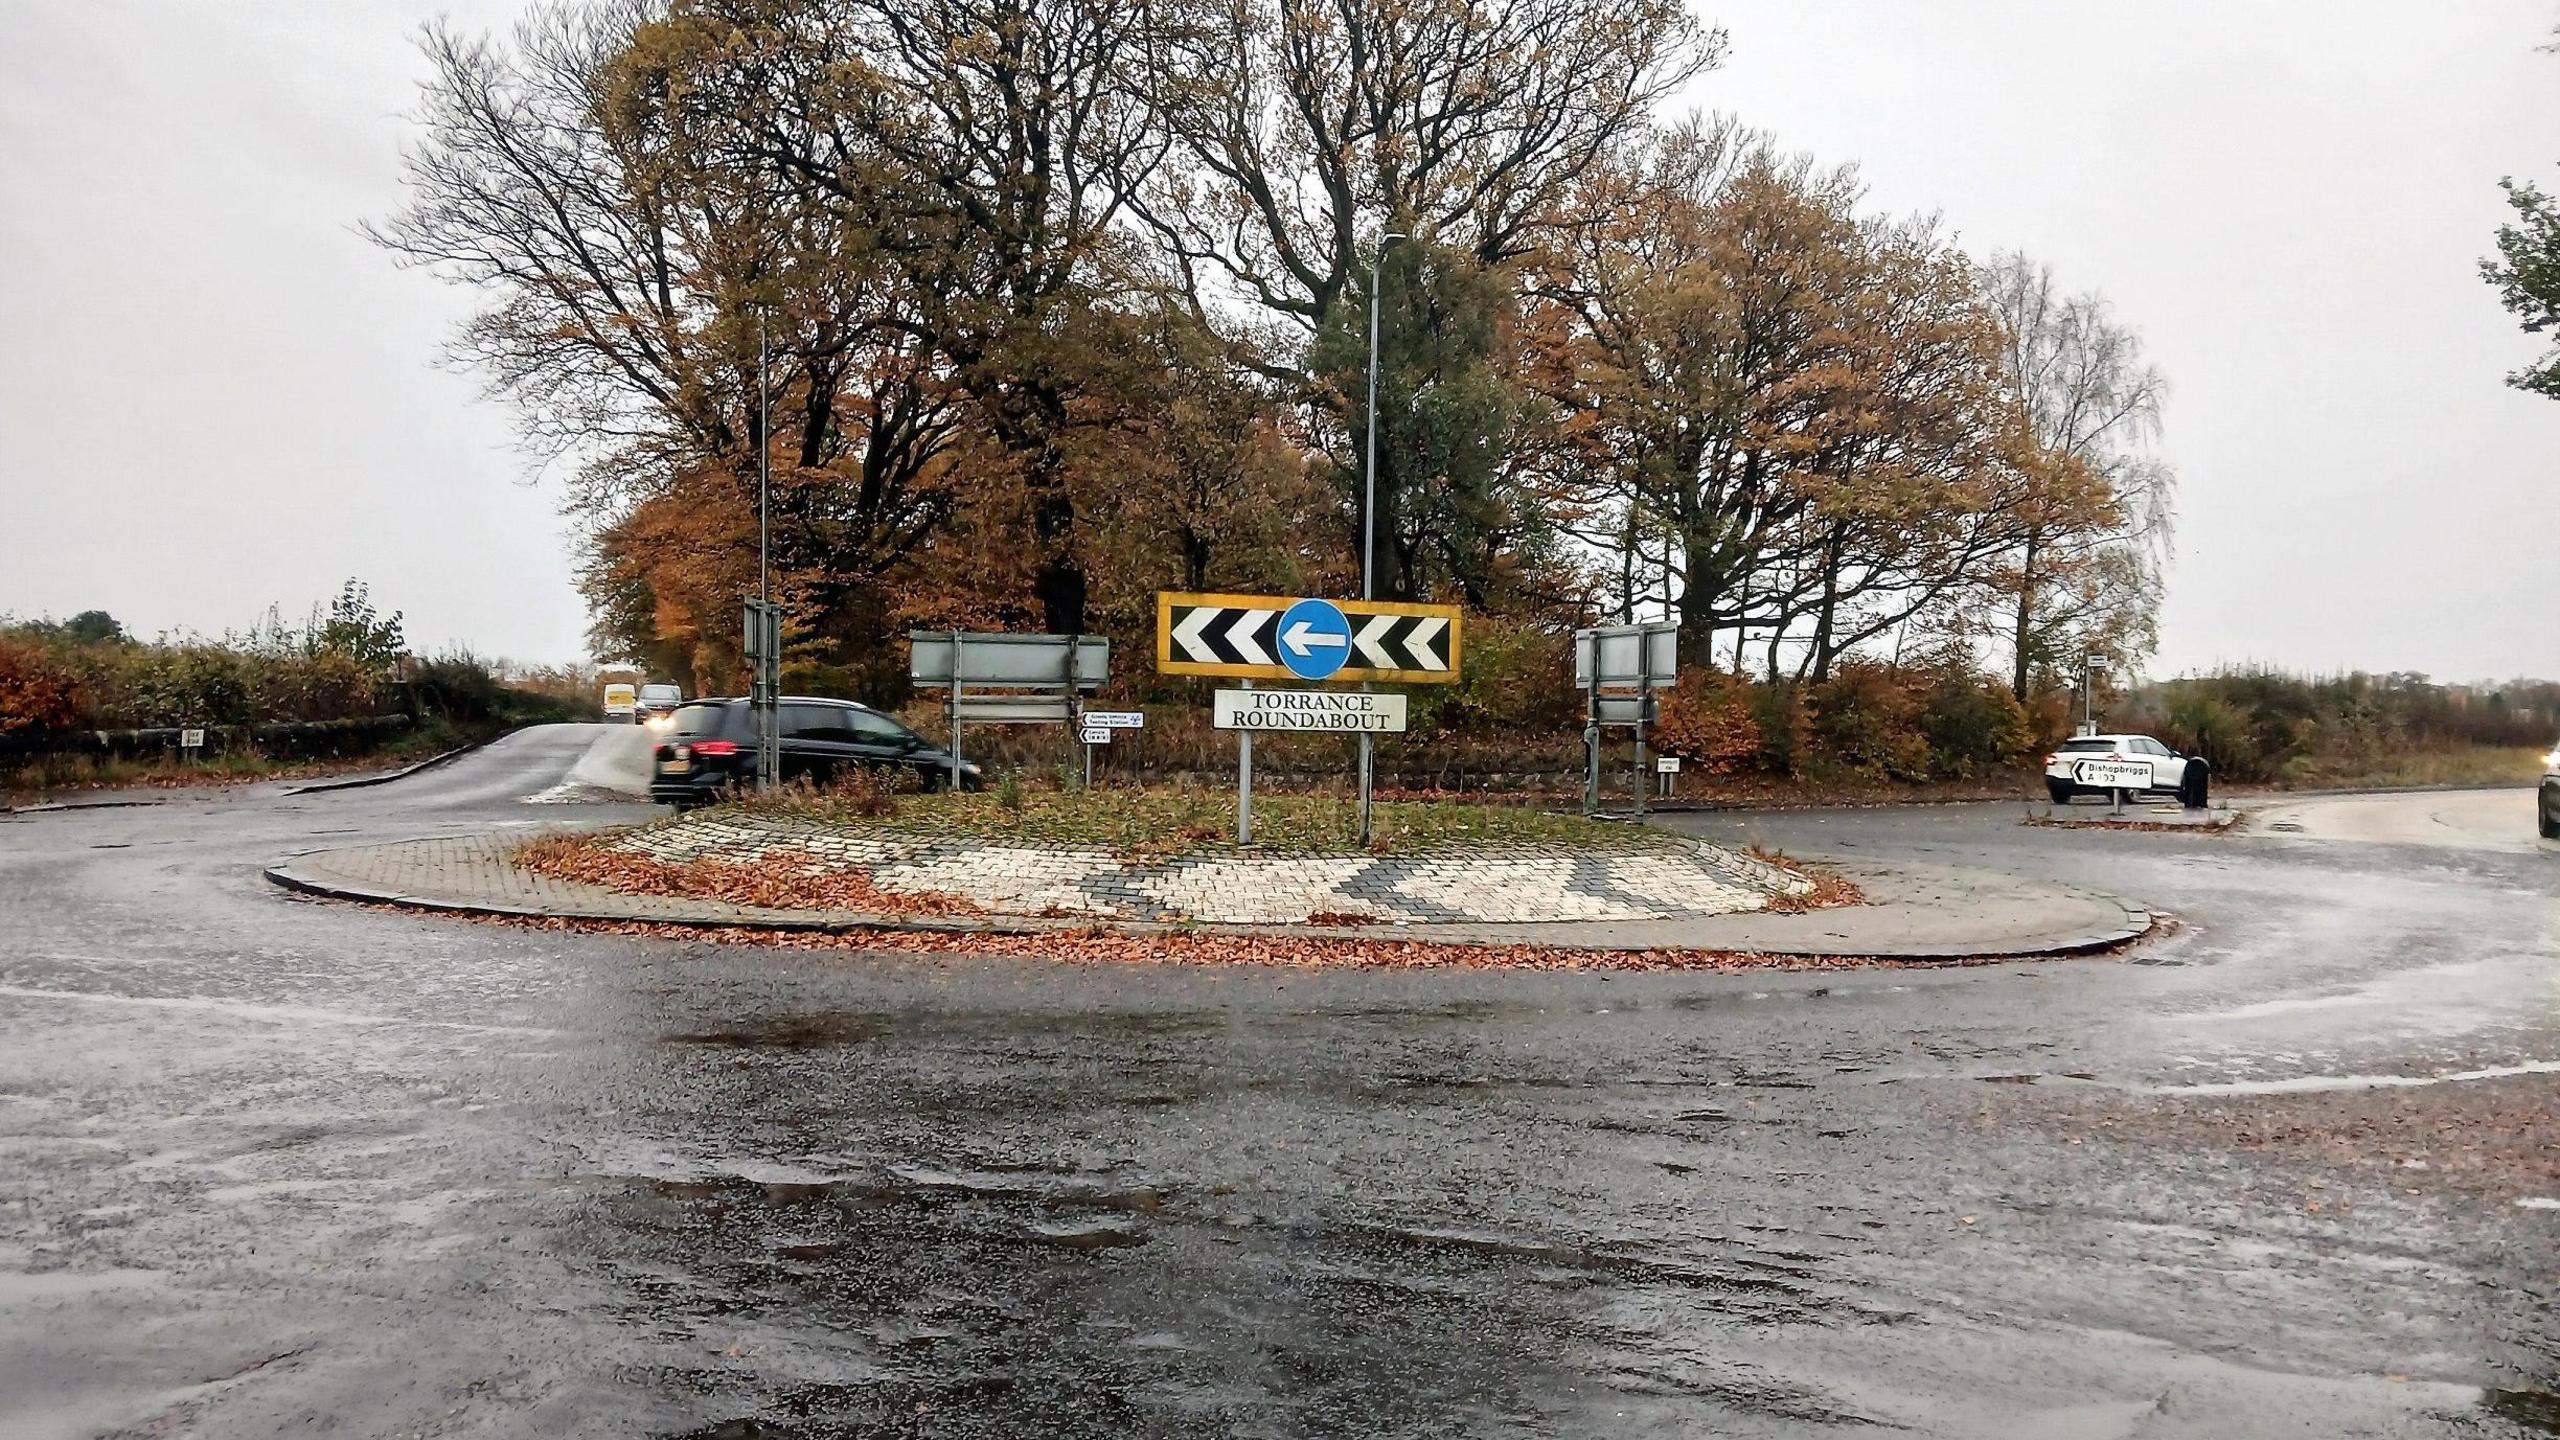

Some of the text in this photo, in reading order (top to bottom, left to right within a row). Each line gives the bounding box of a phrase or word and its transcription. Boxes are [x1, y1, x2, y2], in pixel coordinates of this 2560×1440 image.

[1251, 693, 1373, 711] TORRANCE
[1232, 711, 1390, 729] ROUNDABOUT
[2088, 763, 2149, 776] Bishopbriggs
